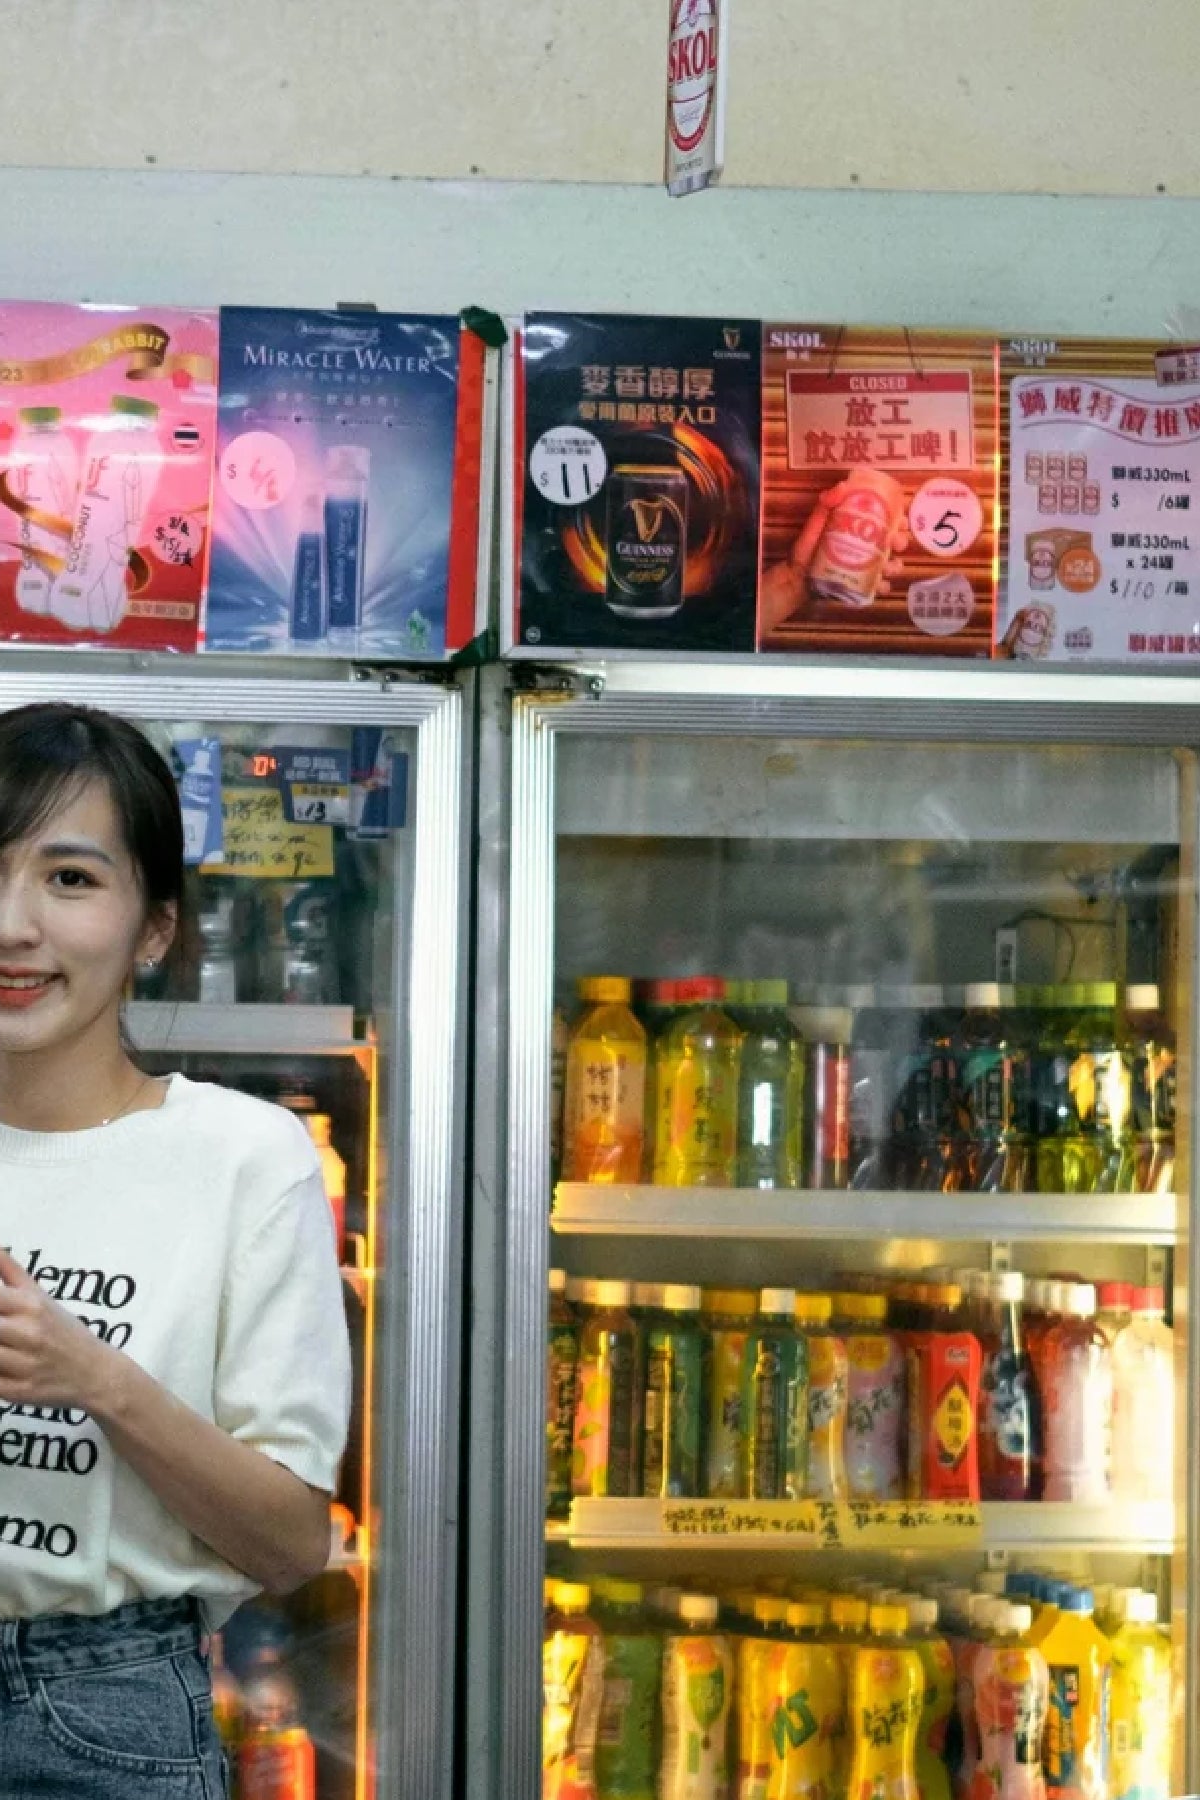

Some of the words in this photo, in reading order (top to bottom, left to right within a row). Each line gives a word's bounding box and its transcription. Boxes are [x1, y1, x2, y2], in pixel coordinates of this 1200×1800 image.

[769, 332, 825, 348] SKOL
[243, 346, 344, 370] MIRACLE
[354, 348, 430, 373] WATER
[849, 377, 908, 390] CLOSED
[845, 396, 912, 428] 放工
[933, 510, 962, 548] 5
